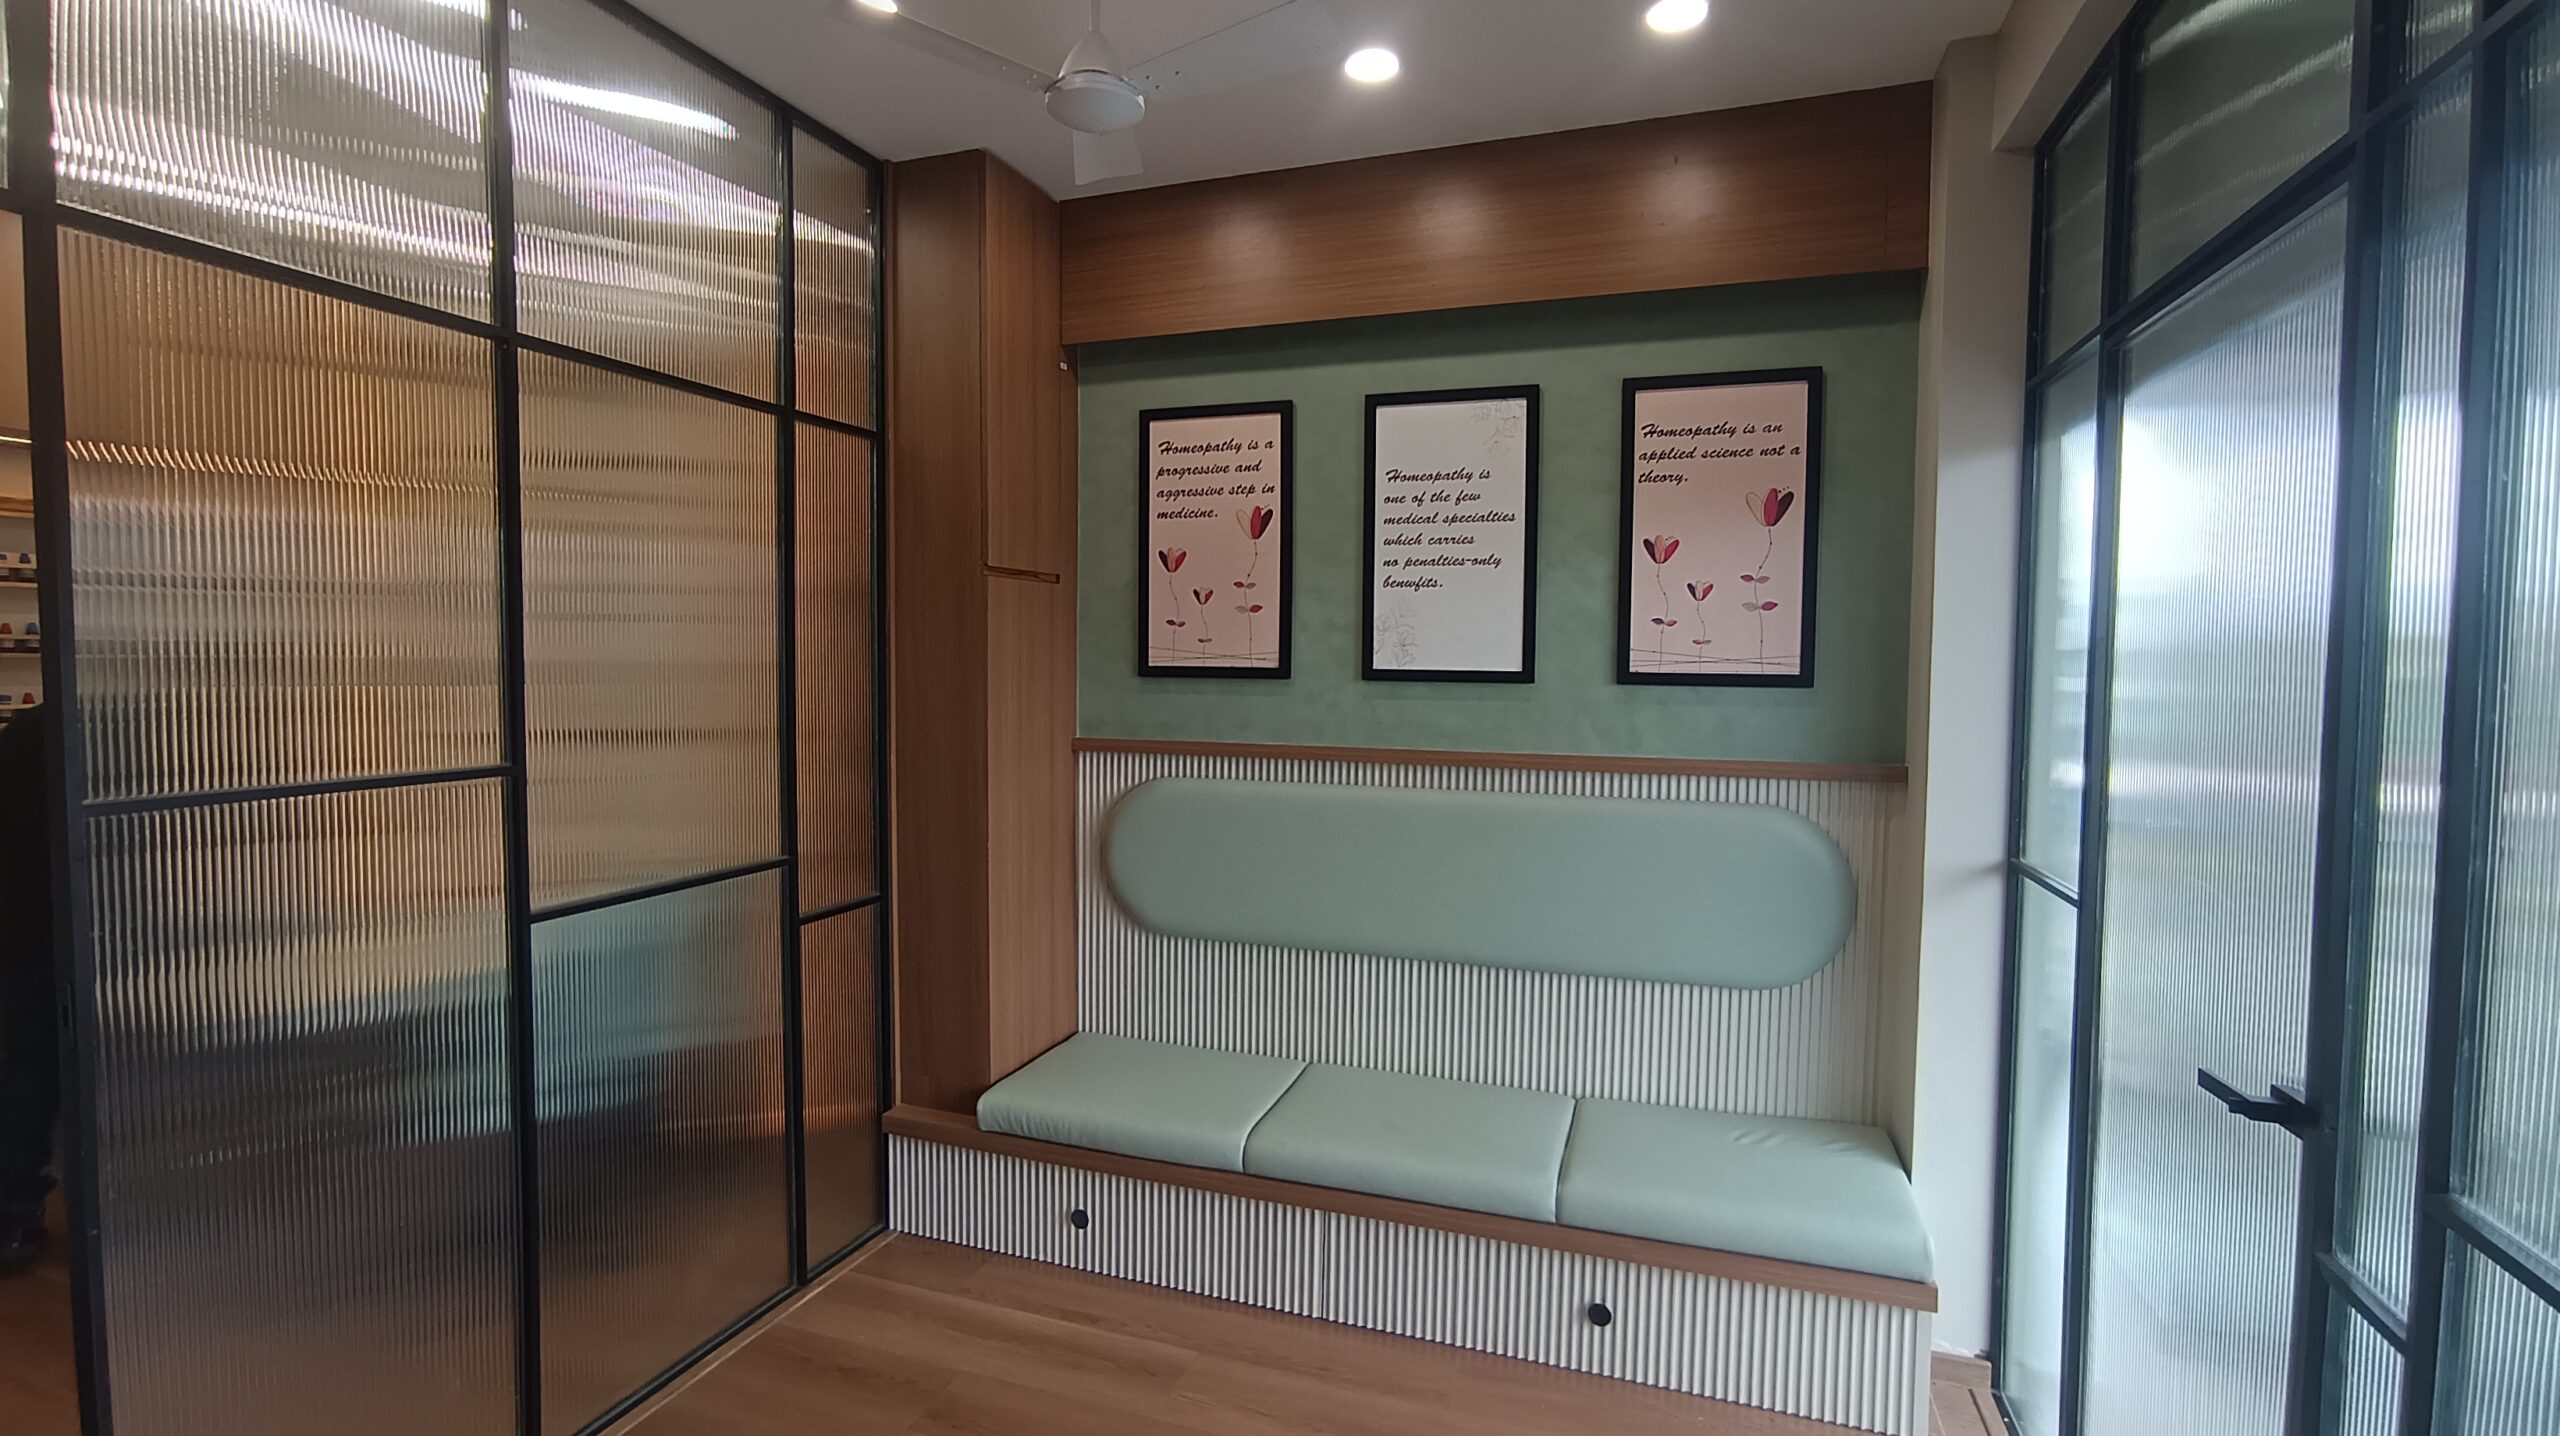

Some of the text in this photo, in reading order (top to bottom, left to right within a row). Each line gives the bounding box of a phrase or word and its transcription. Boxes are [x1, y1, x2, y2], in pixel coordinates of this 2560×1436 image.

[1641, 421, 1783, 440] Homeopathy is an
[1158, 438, 1274, 456] Homeopathy is a
[1638, 444, 1801, 464] applied science not a
[1155, 459, 1262, 480] progressive and
[1385, 467, 1491, 484] Homeopathy is
[1638, 469, 1689, 486] theory.
[1157, 483, 1276, 502] aggressive step in
[1383, 489, 1481, 507] one of the few
[1157, 507, 1218, 519] medicine.
[1383, 510, 1516, 526] medical specialties
[1383, 533, 1475, 546] which carries
[1383, 553, 1502, 570] no penalties-only
